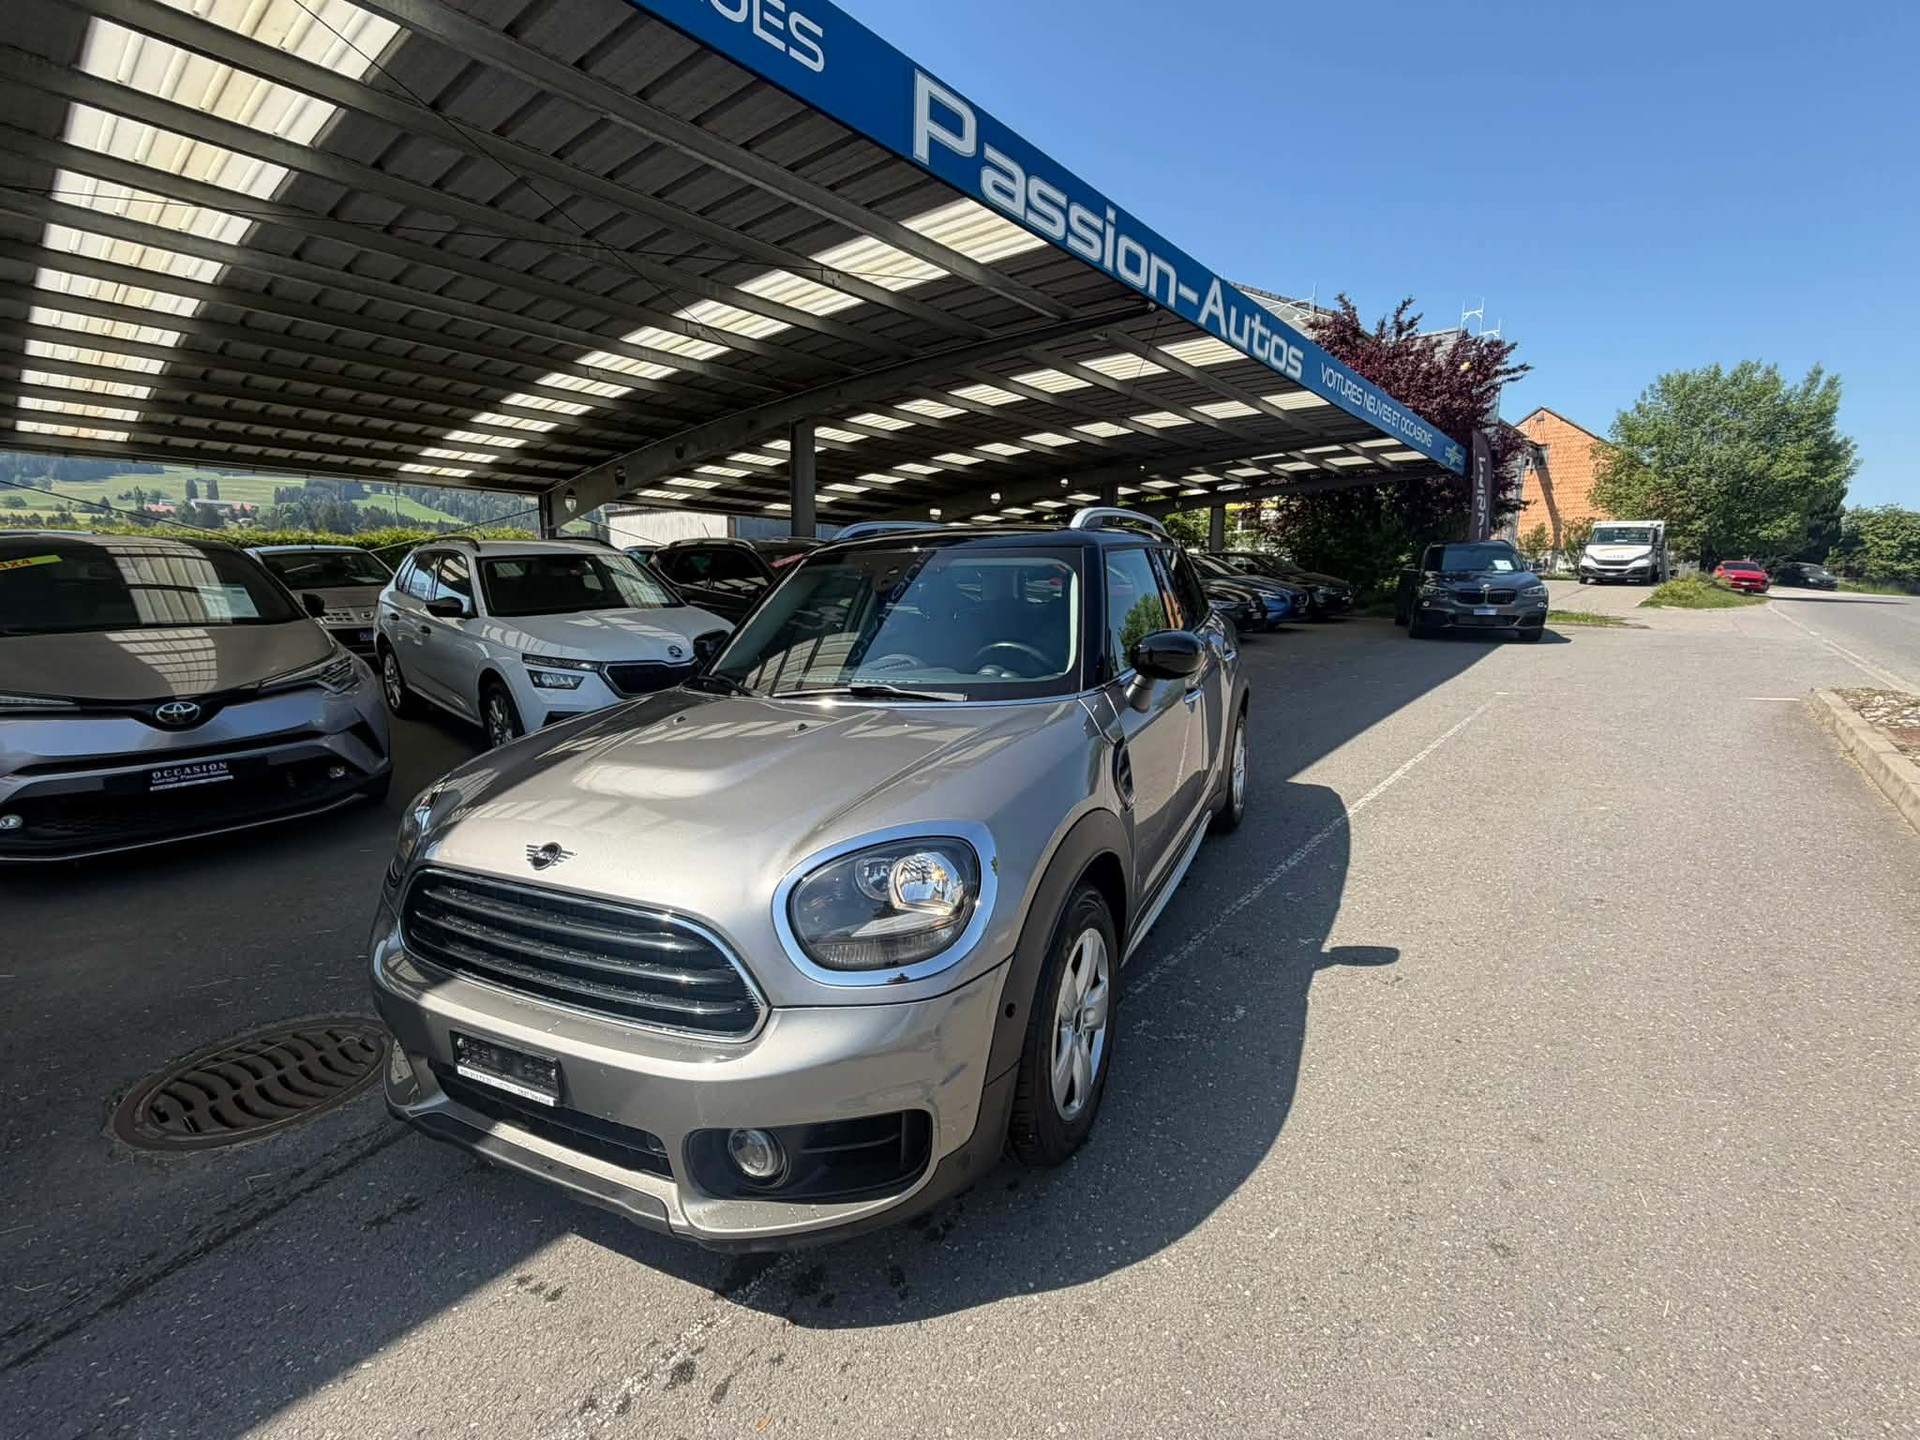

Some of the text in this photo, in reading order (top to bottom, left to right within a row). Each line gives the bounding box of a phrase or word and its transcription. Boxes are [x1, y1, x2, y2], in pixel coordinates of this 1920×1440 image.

[913, 67, 1304, 380] Passion-Autos
[1320, 361, 1433, 448] VOITURES NEUVES ET OCCASIONS
[152, 762, 227, 779] OCCASION
